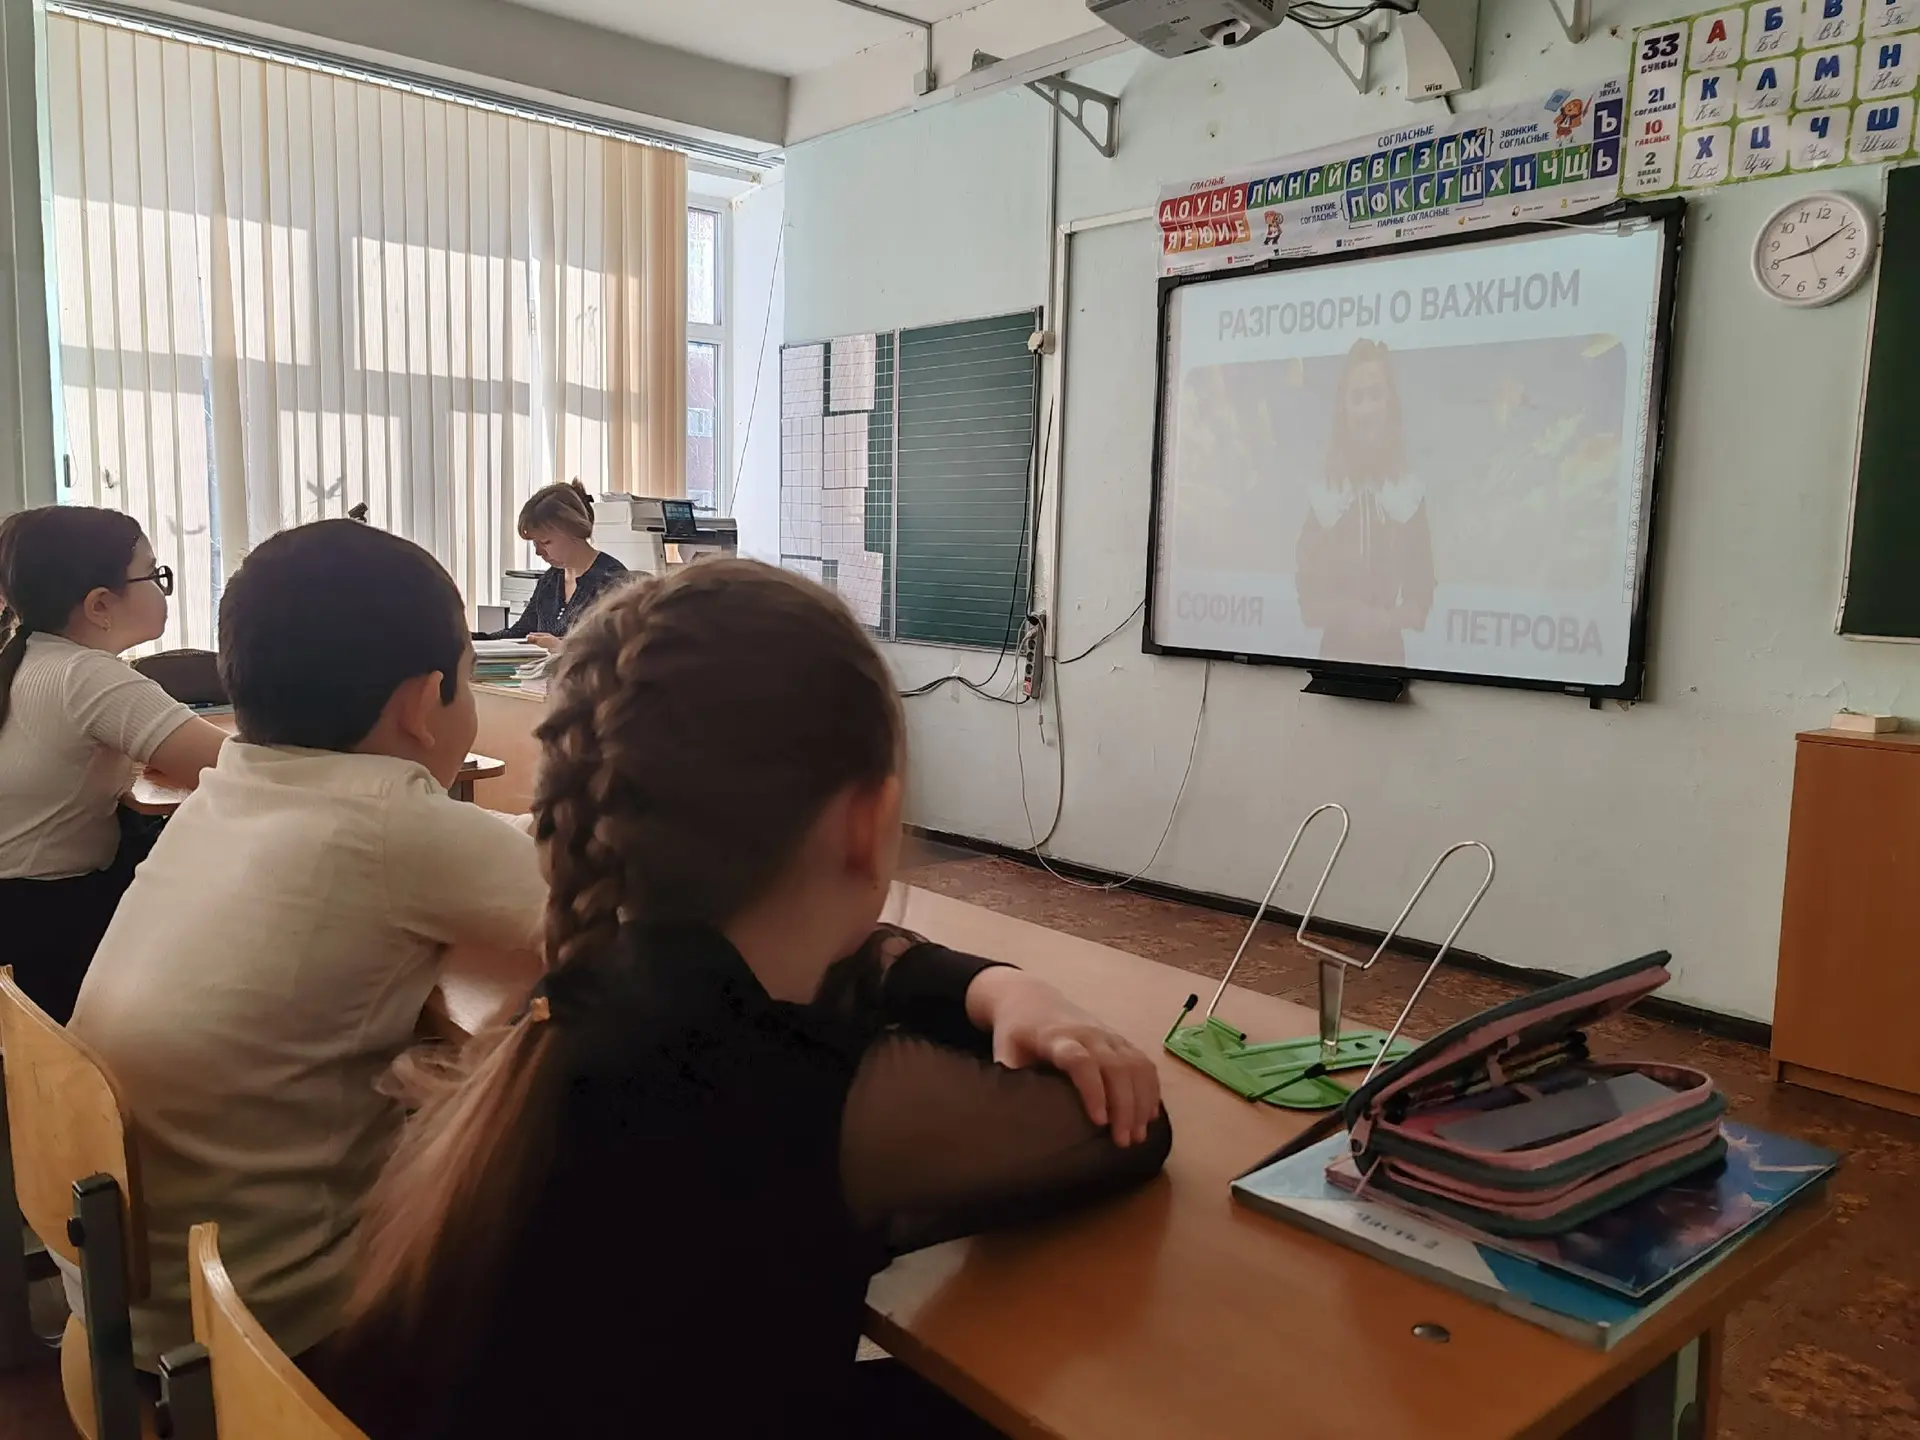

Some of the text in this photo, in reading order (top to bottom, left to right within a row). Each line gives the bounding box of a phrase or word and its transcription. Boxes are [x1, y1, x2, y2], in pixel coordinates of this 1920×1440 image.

[1706, 19, 1727, 44] А
[1764, 6, 1784, 32] Б
[1642, 32, 1680, 60] 33
[1640, 58, 1678, 74] БУКВЫ
[1700, 44, 1901, 101] К Л М Н
[1604, 80, 1617, 89] НЕТ
[1598, 87, 1621, 98] ЗВУКА
[1648, 87, 1665, 104] 21
[1634, 103, 1676, 116] СОГЛАСНАЯ
[1597, 110, 1617, 133] Ъ
[1645, 119, 1663, 135] 10
[1378, 124, 1434, 148] СОГЛАСНЫЕ
[1500, 123, 1539, 139] ЗВОНКИЕ
[1696, 106, 1900, 160] Х Ц Ч Ш
[1499, 132, 1550, 150] СОГЛАСНЫЕ
[1635, 135, 1671, 147] ГЛАСНЫХ
[1645, 152, 1657, 166] 2
[1162, 136, 1485, 222] А О У Ы Э Л М Н Р Й Б В Г З Д Ж
[1190, 176, 1226, 192] ГЛАСНЫЕ
[1352, 150, 1613, 217] П Ф К С Т Ш Х Ц Ч Щ Ь
[1310, 202, 1336, 213] ГЛУХИЕ
[1816, 207, 1832, 220] 12
[1300, 210, 1338, 225] СОГЛАСНЫЕ
[1377, 207, 1450, 228] ПАРНЫЕ СОГЛАСНЫЕ
[1798, 211, 1810, 223] 11
[1840, 215, 1846, 226] 1
[1166, 219, 1246, 251] Я Ё Ю И Е
[1781, 222, 1795, 234] 10
[1845, 228, 1856, 240] 2
[1771, 240, 1780, 252] 9
[1846, 248, 1856, 259] 3
[1771, 259, 1780, 270] 8
[1835, 265, 1845, 277] 4
[1780, 274, 1790, 286] 7
[1797, 281, 1806, 292] 6
[1817, 277, 1828, 290] 5
[1218, 269, 1581, 341] РАЗГОВОРЫ О ВАЖНОМ
[1177, 590, 1264, 628] СОФИЯ
[1446, 608, 1603, 657] ПЕТРОВА
